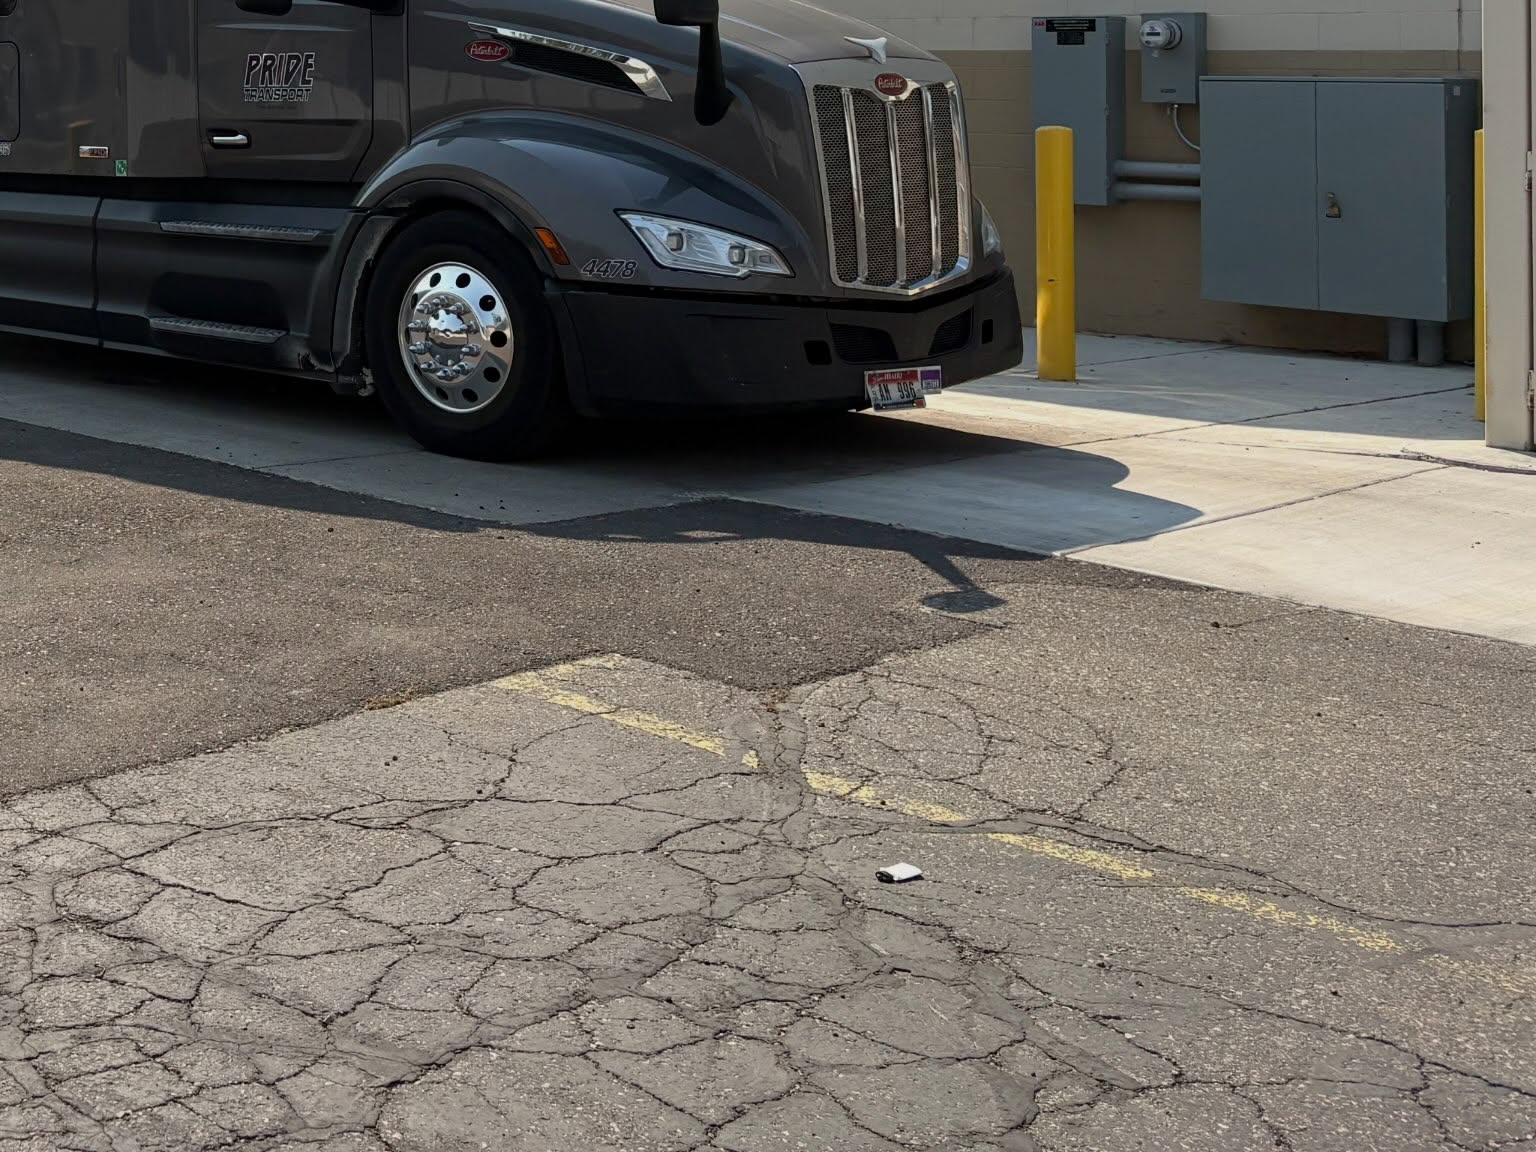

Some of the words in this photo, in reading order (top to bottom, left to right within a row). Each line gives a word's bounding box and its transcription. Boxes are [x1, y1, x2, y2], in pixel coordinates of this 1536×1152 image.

[470, 44, 505, 56] Peterbilt
[244, 53, 315, 87] PRIDE
[244, 88, 312, 101] TRANSPORT
[580, 259, 639, 278] 4478
